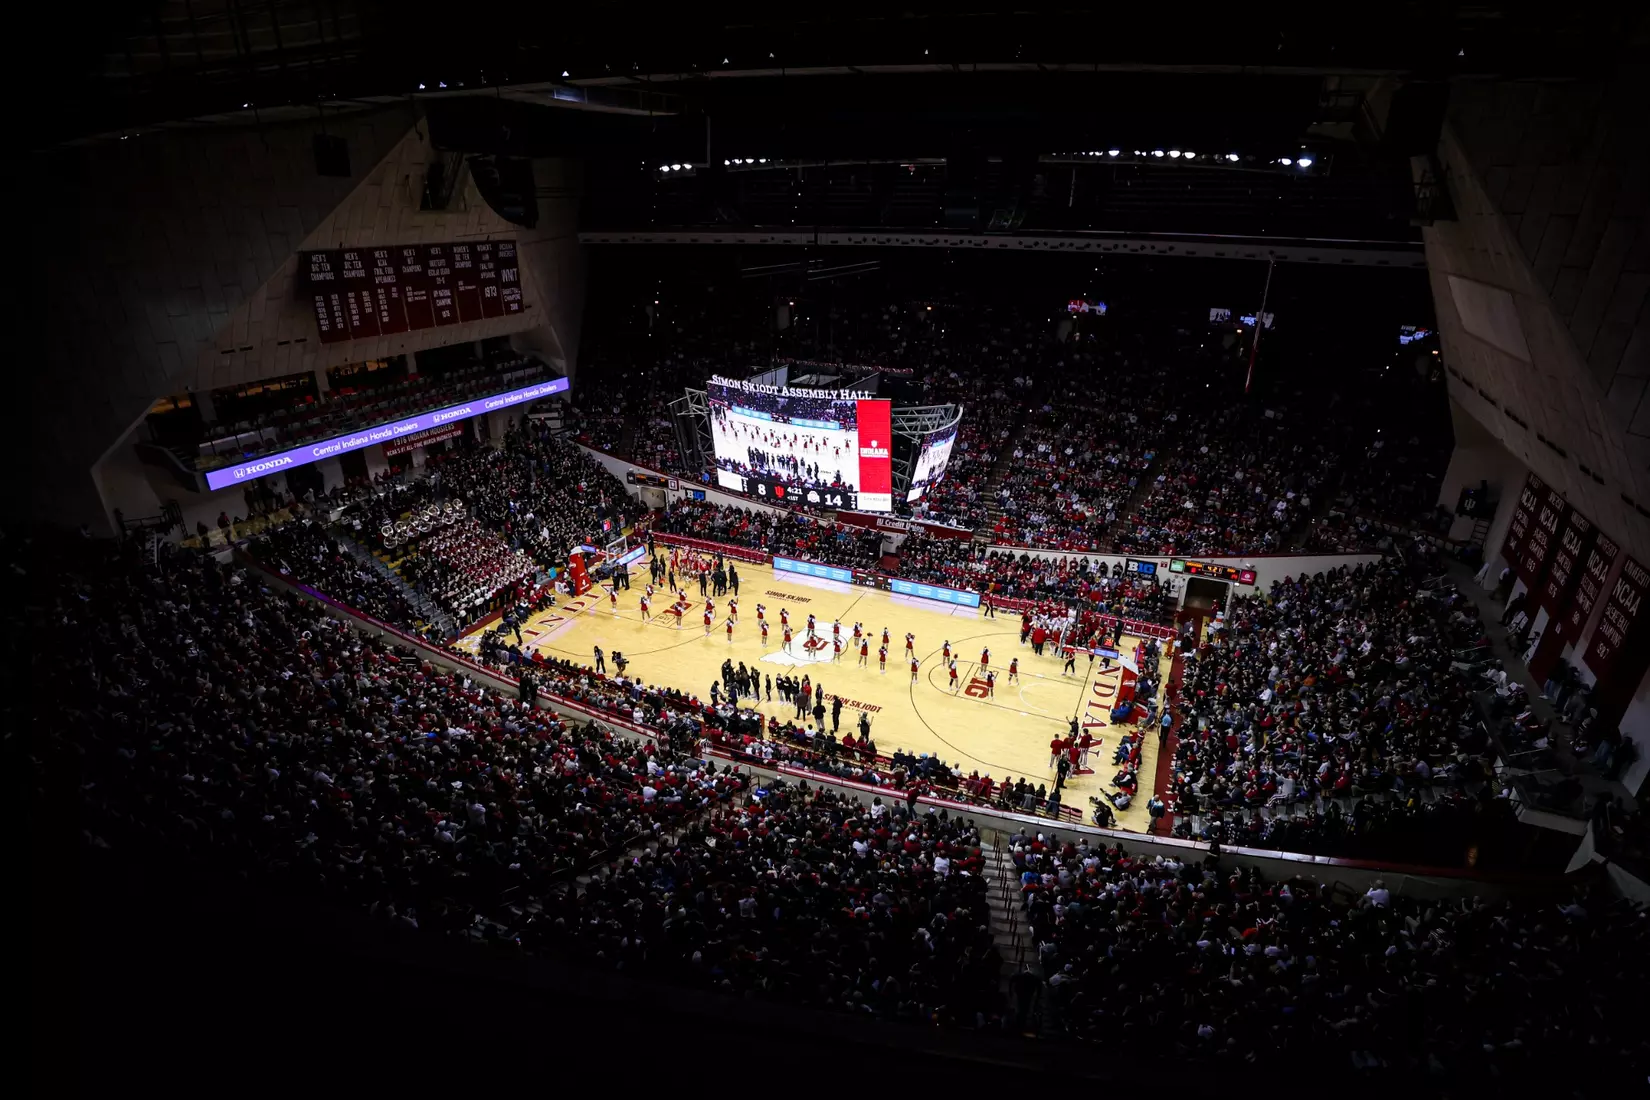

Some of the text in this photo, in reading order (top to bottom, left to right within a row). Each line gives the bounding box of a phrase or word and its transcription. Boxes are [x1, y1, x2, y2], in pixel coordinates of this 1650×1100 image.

[711, 374, 740, 389] SIMON
[782, 386, 836, 400] ASSEMBLY
[841, 390, 872, 400] HALL
[484, 384, 557, 410] Central Indiana Honda Dealers
[440, 406, 472, 421] HONDA
[312, 422, 418, 457] Central Indiana Honda Dealers
[246, 456, 293, 475] HONDA
[757, 483, 767, 496] 8
[787, 487, 803, 495] 4:21
[825, 494, 843, 507] 14
[885, 519, 904, 529] Credit
[1539, 505, 1559, 535] NCAA
[1562, 526, 1582, 558] NCAA
[1586, 548, 1609, 585] NCAA
[765, 590, 786, 599] SIMON
[786, 594, 812, 604] SKJODT
[1611, 576, 1642, 617] NCAA
[850, 700, 883, 713] SKJODT
